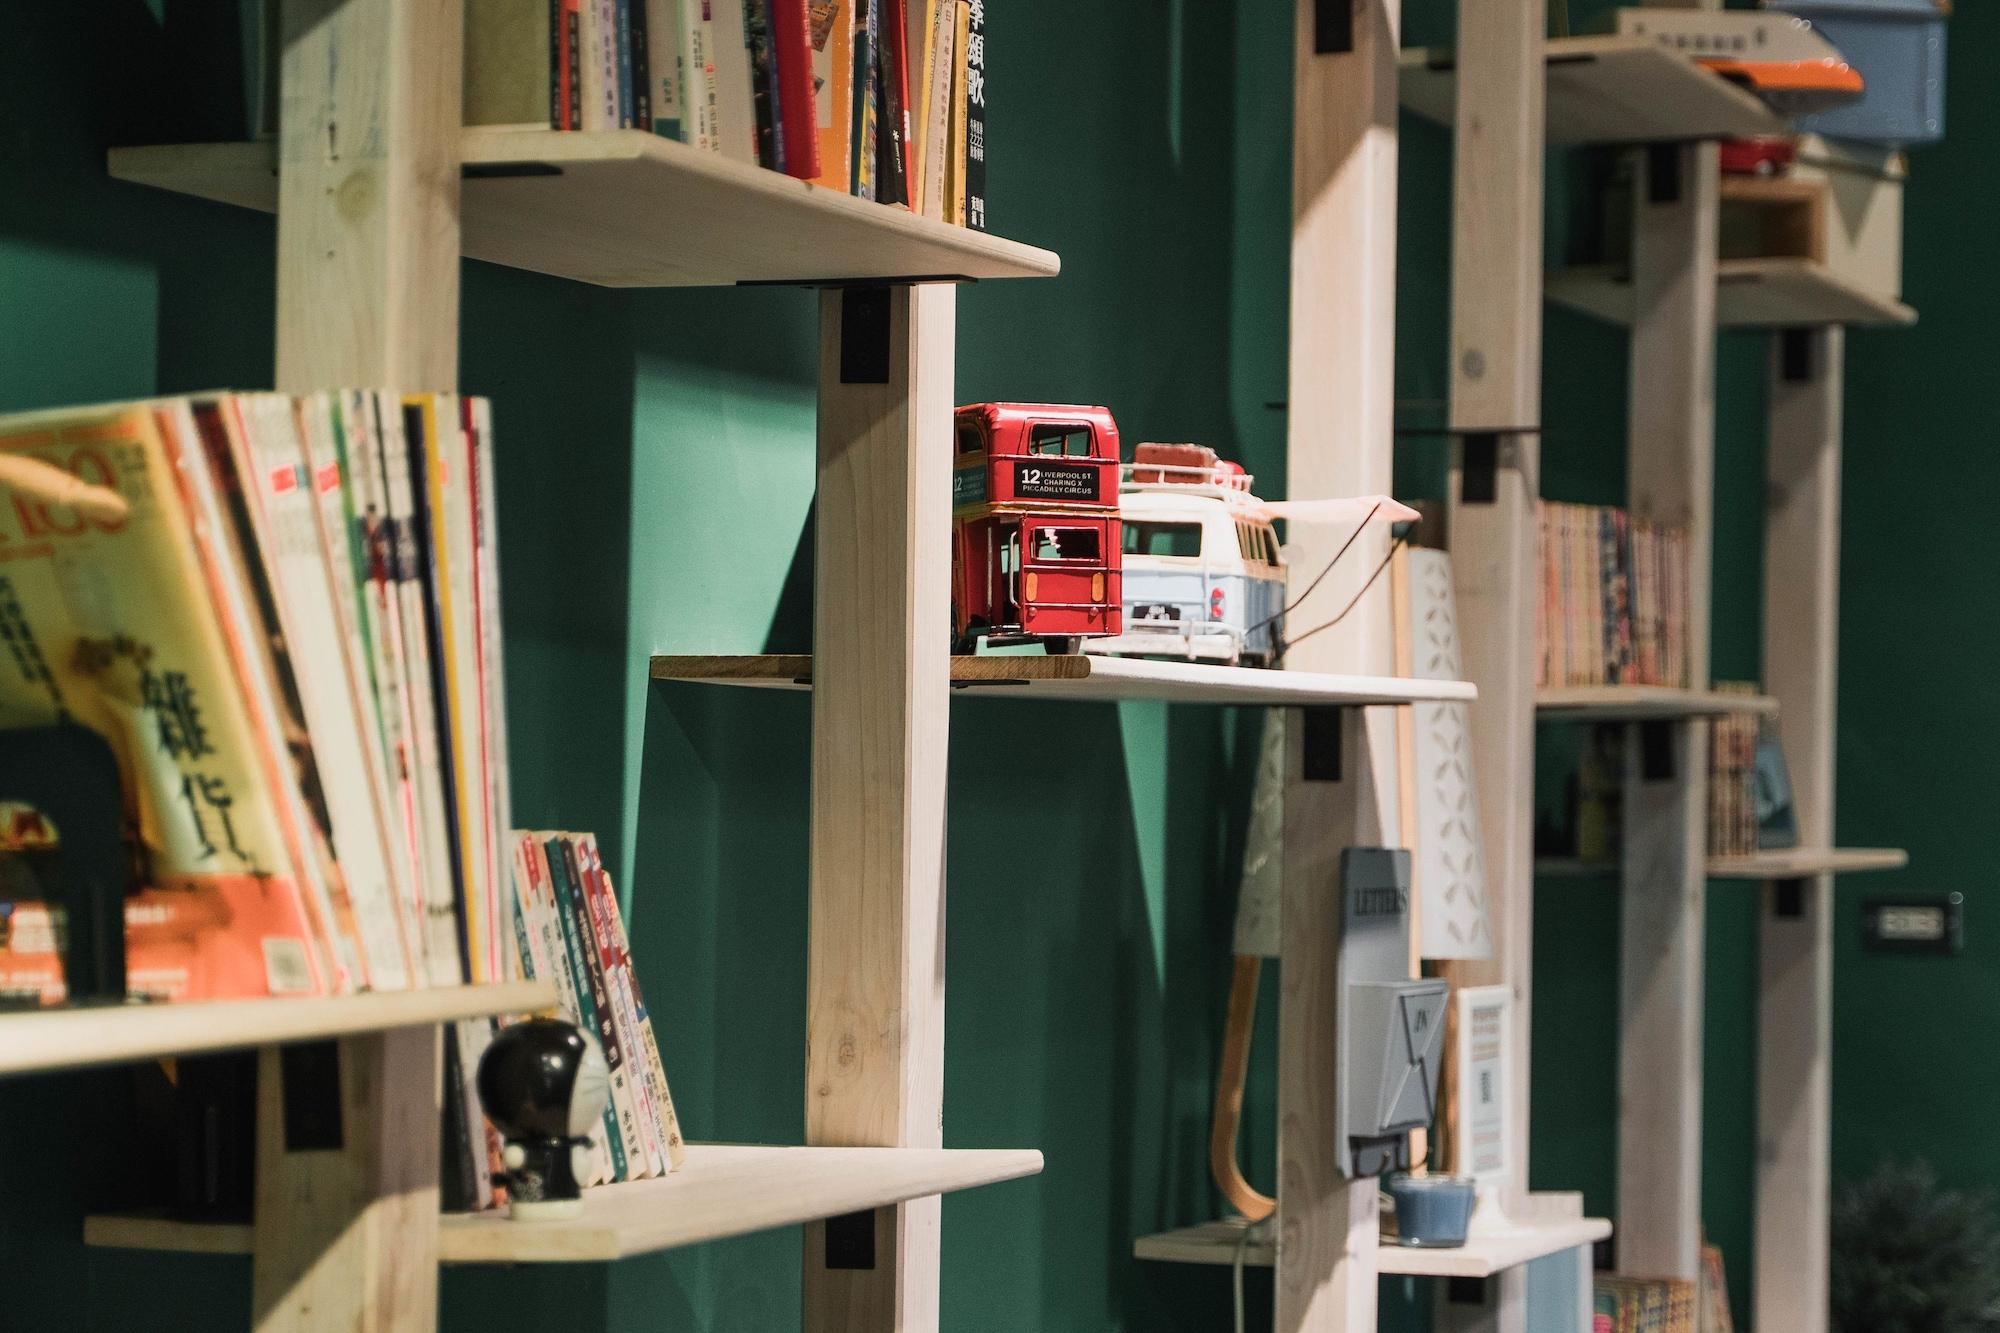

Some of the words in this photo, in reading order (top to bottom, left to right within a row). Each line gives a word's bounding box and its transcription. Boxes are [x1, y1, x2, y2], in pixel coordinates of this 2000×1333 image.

[1021, 469, 1041, 484] 12
[1041, 471, 1081, 480] LIVERPOOL
[1044, 479, 1077, 487] CHARING
[1022, 485, 1064, 493] PICCADILLY
[1354, 886, 1408, 916] LETTERS
